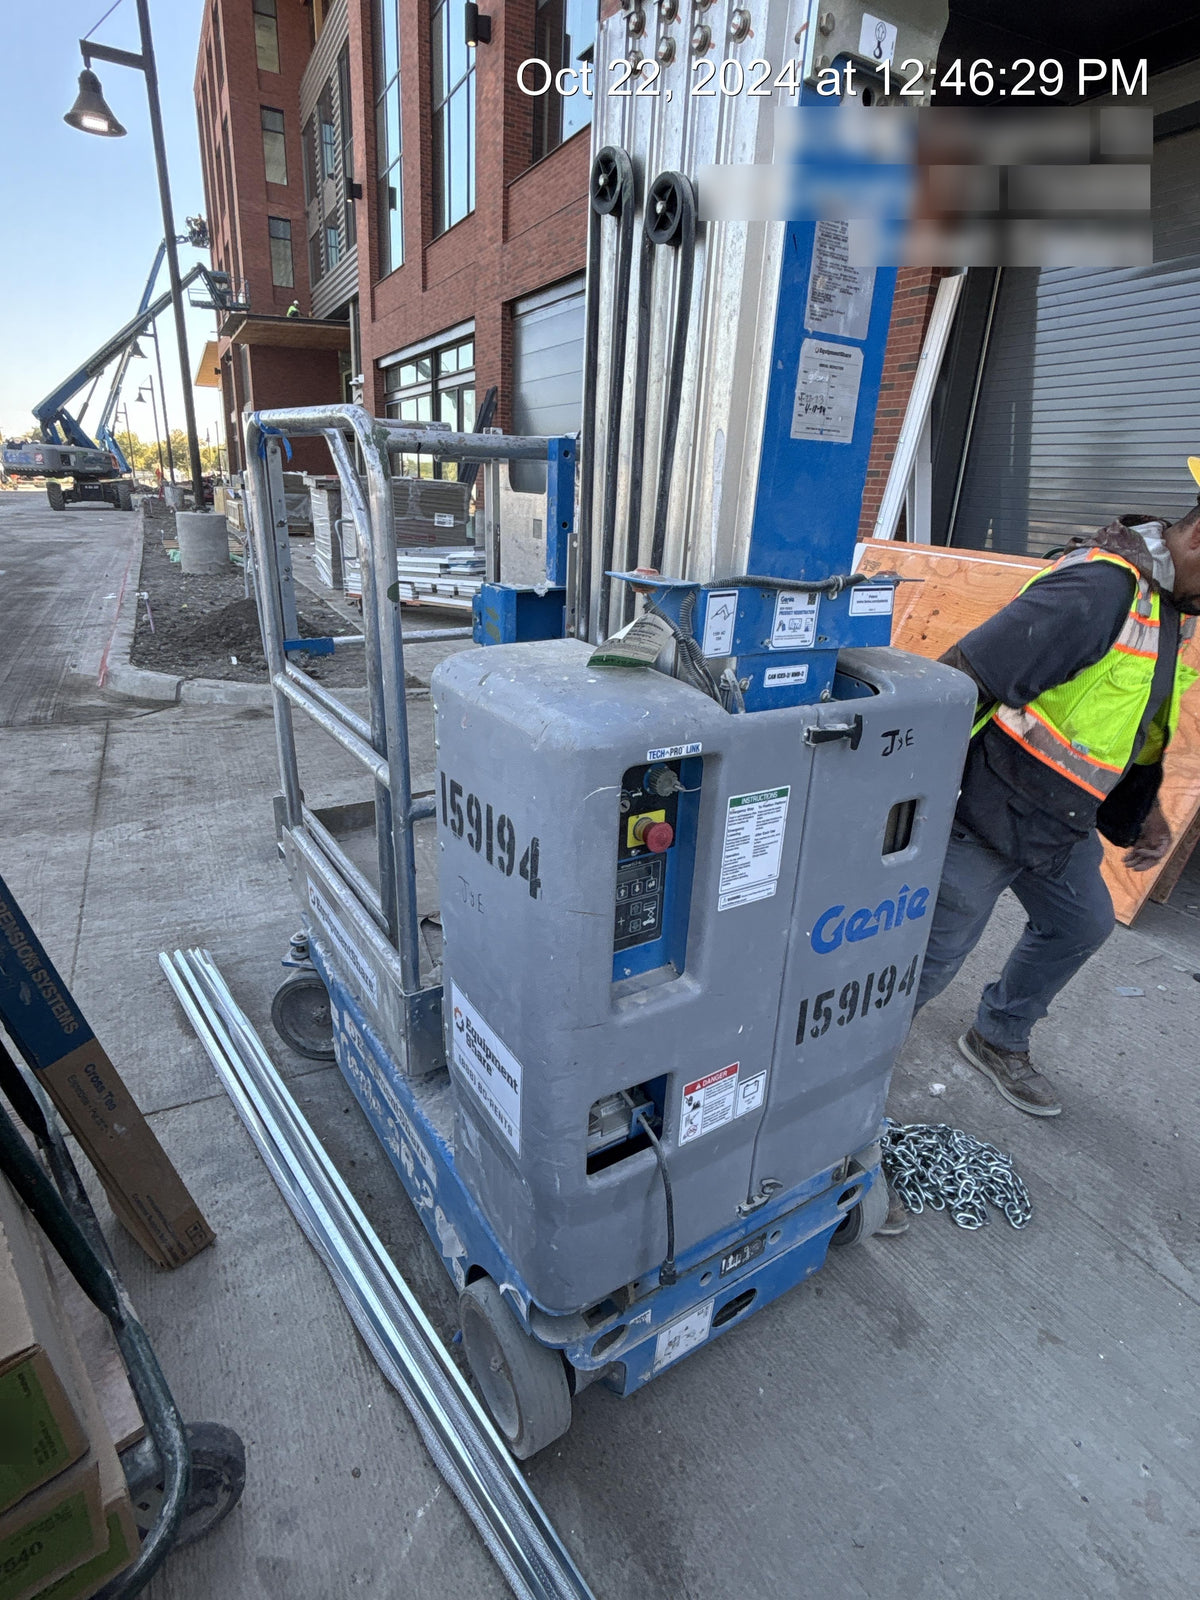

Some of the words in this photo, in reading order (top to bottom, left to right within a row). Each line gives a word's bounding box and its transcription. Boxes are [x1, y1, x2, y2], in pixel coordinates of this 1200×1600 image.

[685, 744, 701, 754] LINK
[741, 791, 778, 805] INSTRUCTIONS
[440, 770, 542, 900] 159194
[811, 884, 930, 955] Genie
[31, 968, 80, 1035] SYSTEMS
[796, 954, 920, 1046] 159194
[84, 1063, 106, 1094] Cross
[465, 1034, 494, 1078] Share
[466, 1015, 519, 1096] Equipment
[702, 1070, 728, 1087] DANGER
